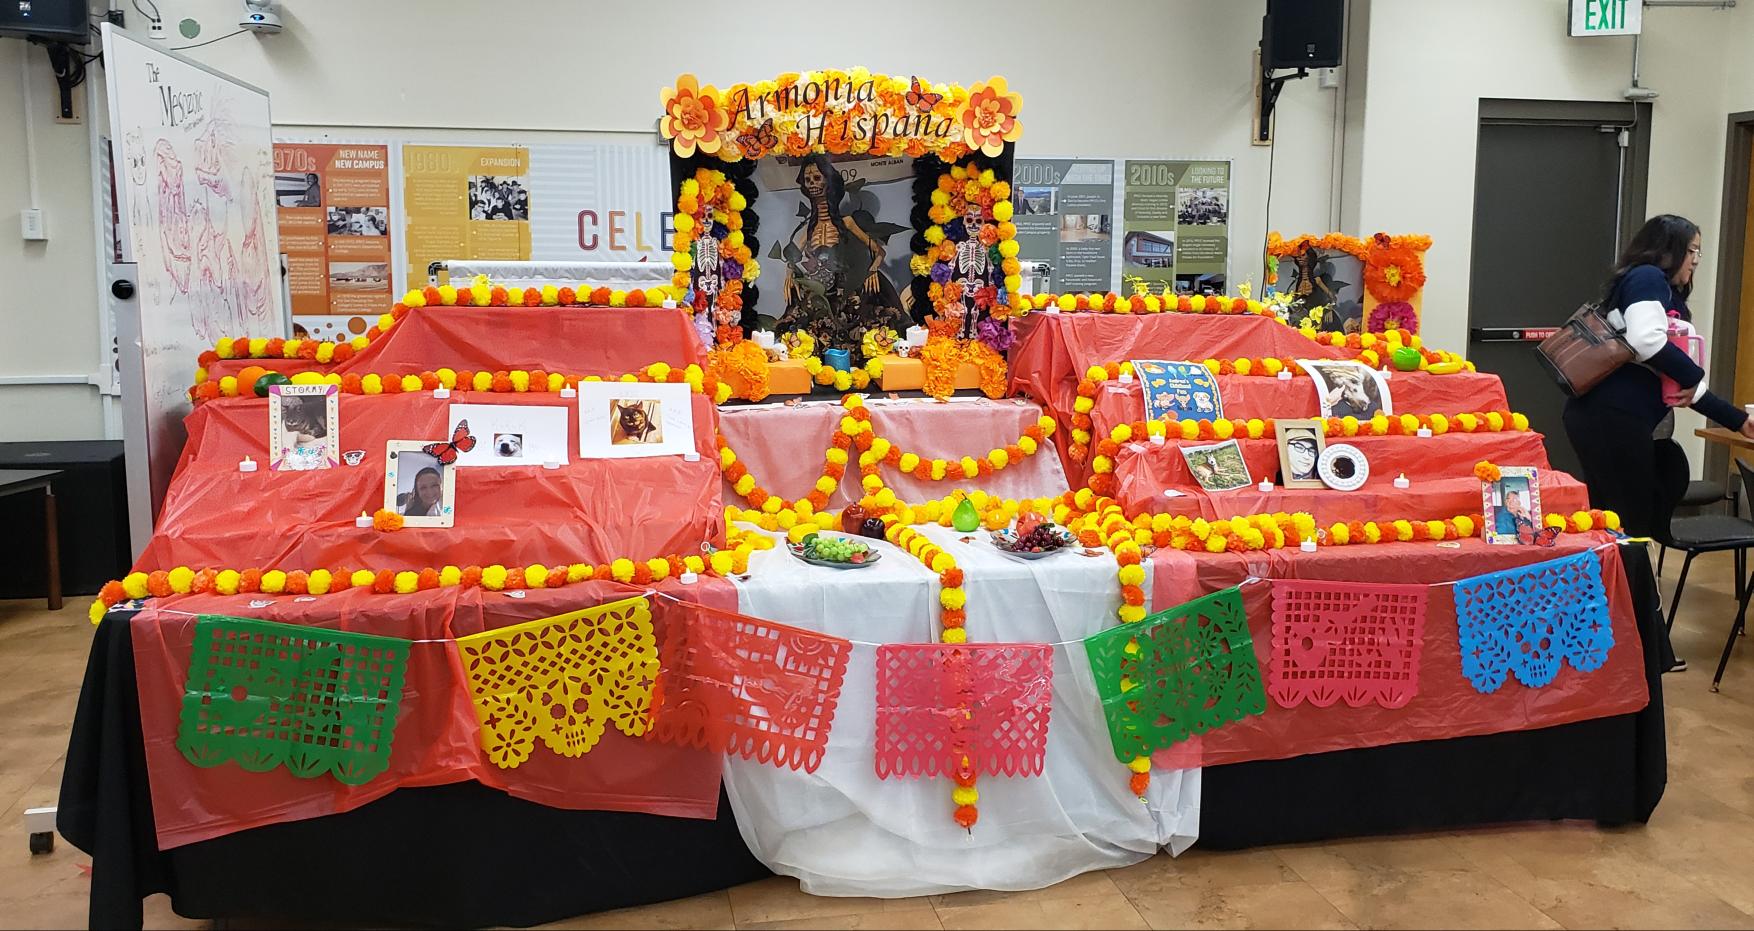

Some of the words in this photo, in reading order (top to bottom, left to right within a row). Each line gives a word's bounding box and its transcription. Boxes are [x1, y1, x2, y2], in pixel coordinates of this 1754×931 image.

[1585, 0, 1629, 30] EXIT
[145, 62, 160, 83] The
[726, 76, 875, 131] Armonia
[796, 110, 954, 150] Hispana
[339, 149, 356, 159] NEW
[357, 149, 379, 159] NAME
[335, 159, 352, 169] NEW
[353, 159, 385, 169] CAMPUS
[481, 157, 521, 168] EXPANSION
[1013, 163, 1061, 185] 2000s
[1130, 164, 1174, 186] 2010s
[1191, 167, 1216, 175] LOOKING
[1217, 167, 1225, 175] TO
[1191, 175, 1202, 184] THE
[1203, 175, 1225, 184] FUTURE
[1525, 331, 1538, 339] PUSH
[1538, 331, 1545, 339] TO
